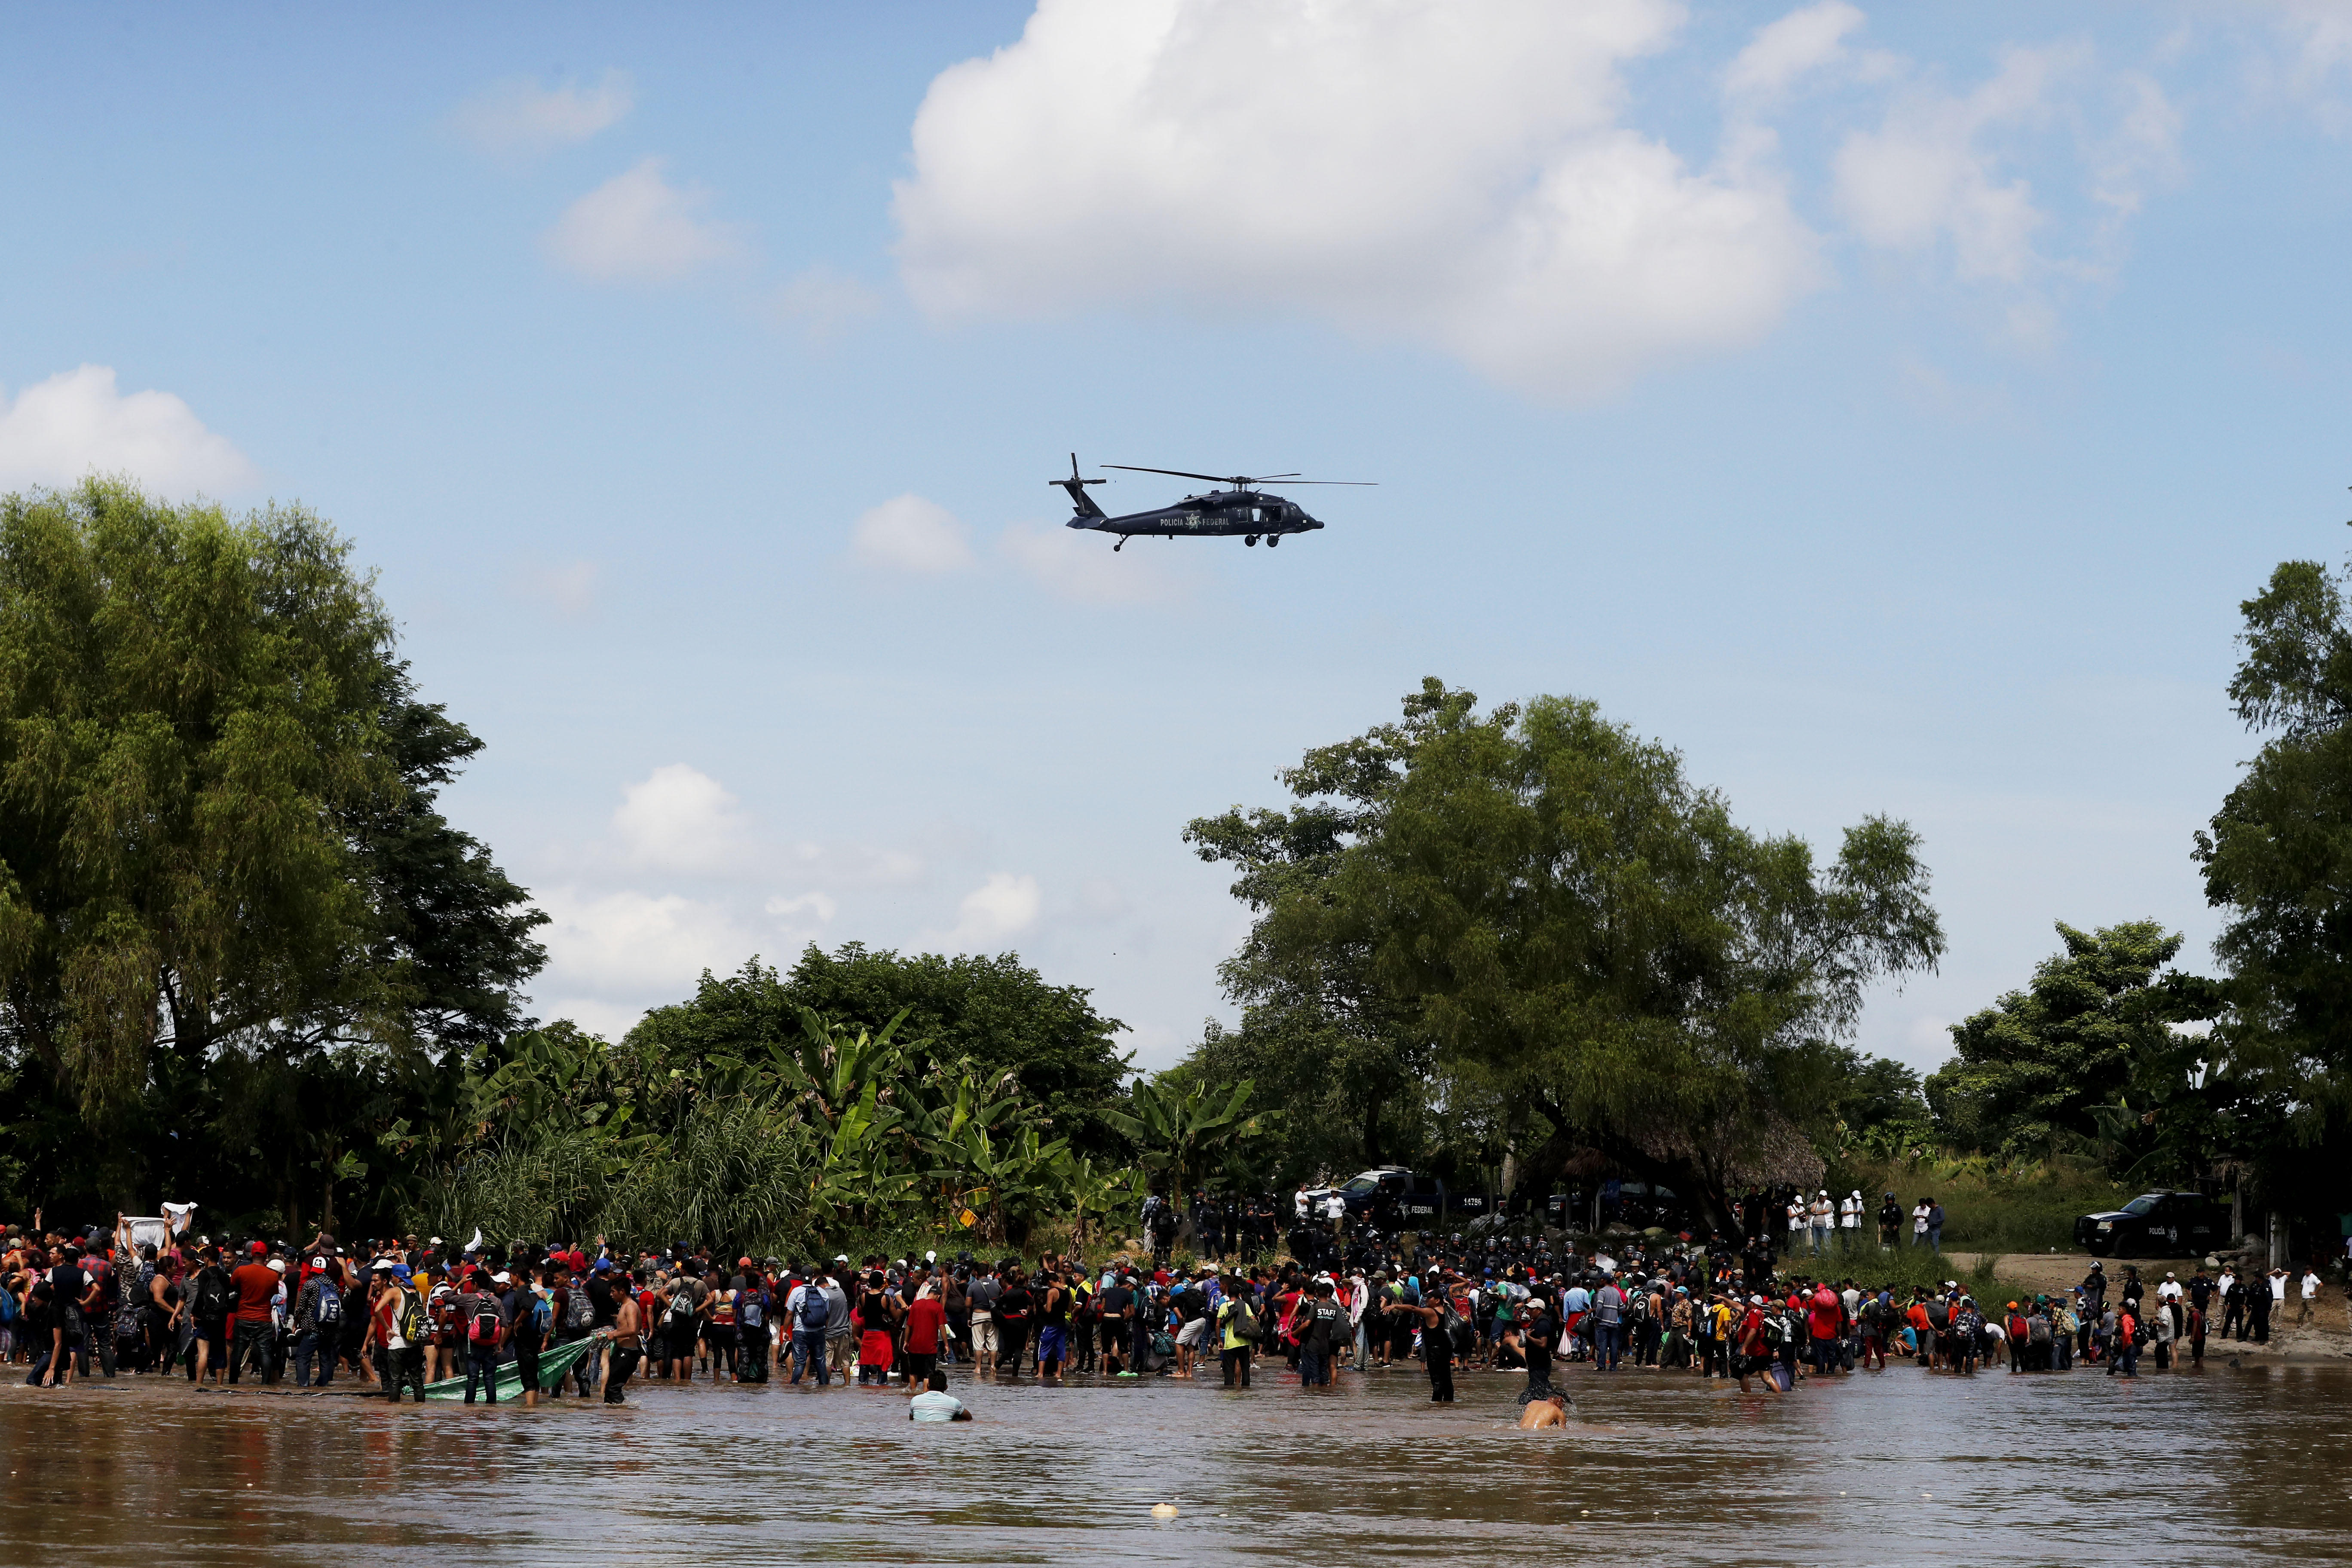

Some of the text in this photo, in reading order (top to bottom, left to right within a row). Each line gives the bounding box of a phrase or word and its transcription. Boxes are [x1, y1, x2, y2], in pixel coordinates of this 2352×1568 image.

[1161, 518, 1183, 526] POLICÍA
[1464, 1197, 1482, 1206] 14786
[2149, 1226, 2165, 1234] POLICÍA
[1317, 1308, 1336, 1317] STAFF
